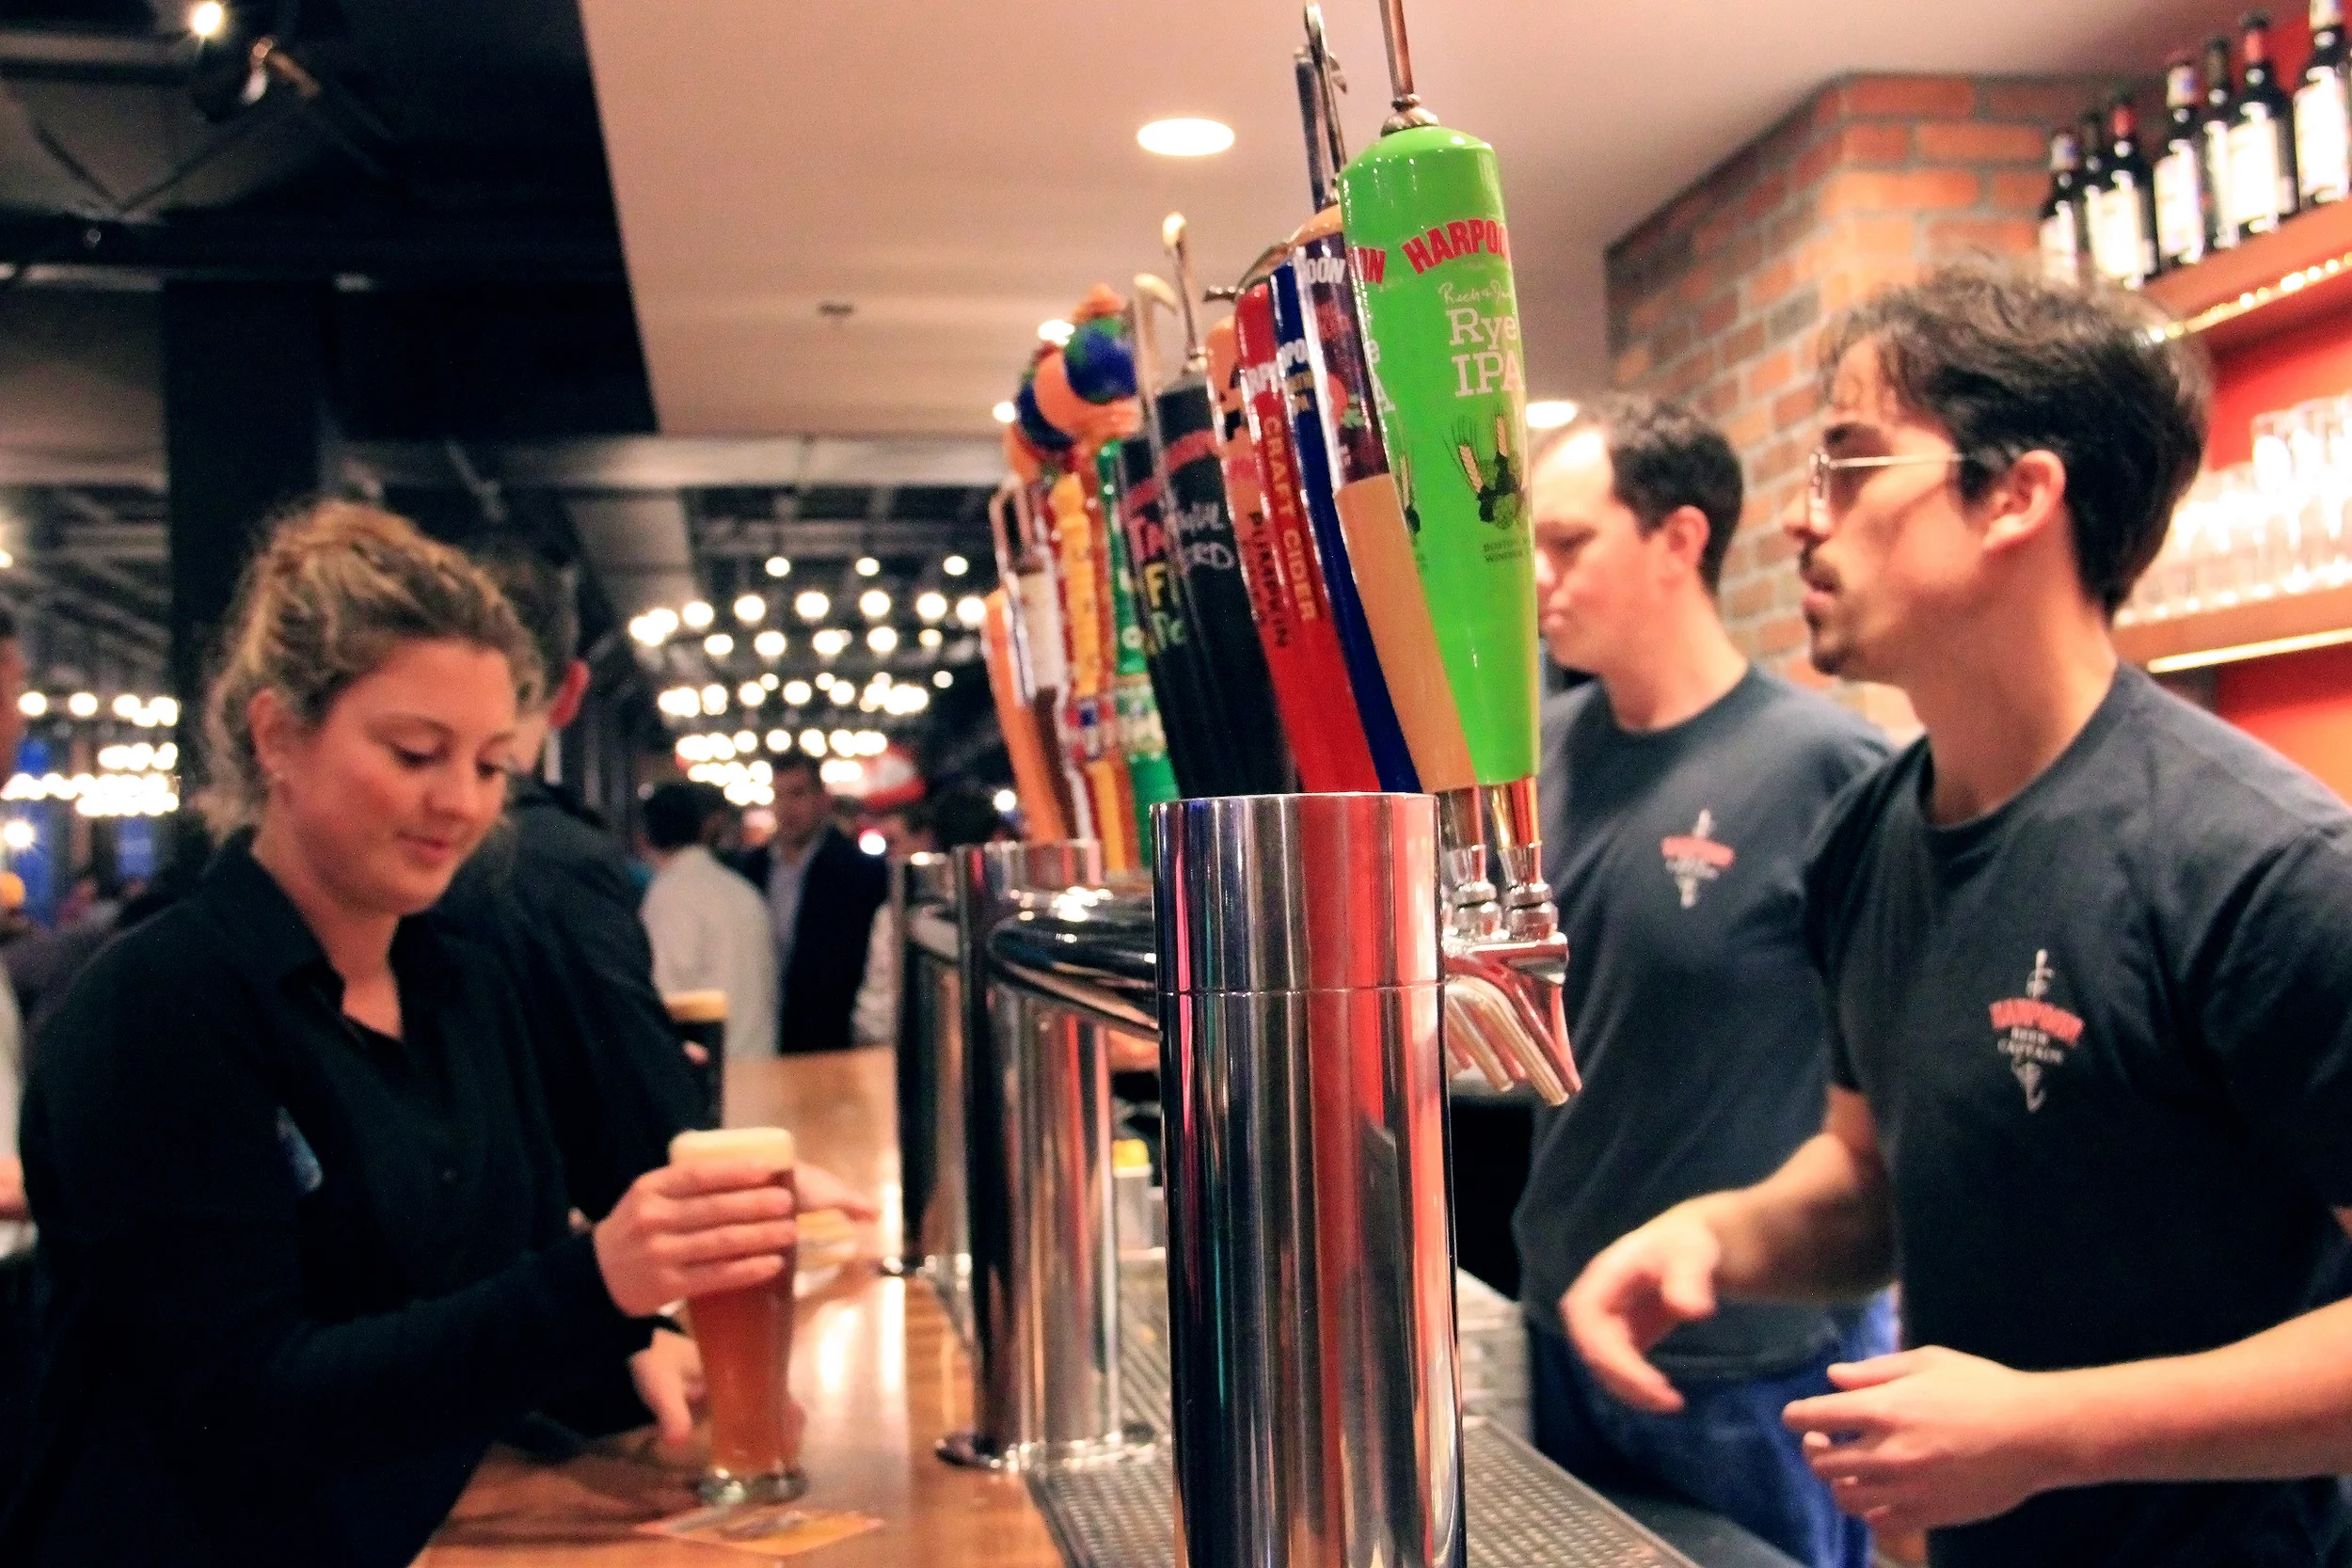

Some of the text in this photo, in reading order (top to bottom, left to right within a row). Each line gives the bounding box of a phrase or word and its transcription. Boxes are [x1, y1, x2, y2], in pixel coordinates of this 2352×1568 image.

[1446, 308, 1518, 351] Rye
[1452, 351, 1524, 397] IPA
[1263, 416, 1316, 622] CRAFT CIDER
